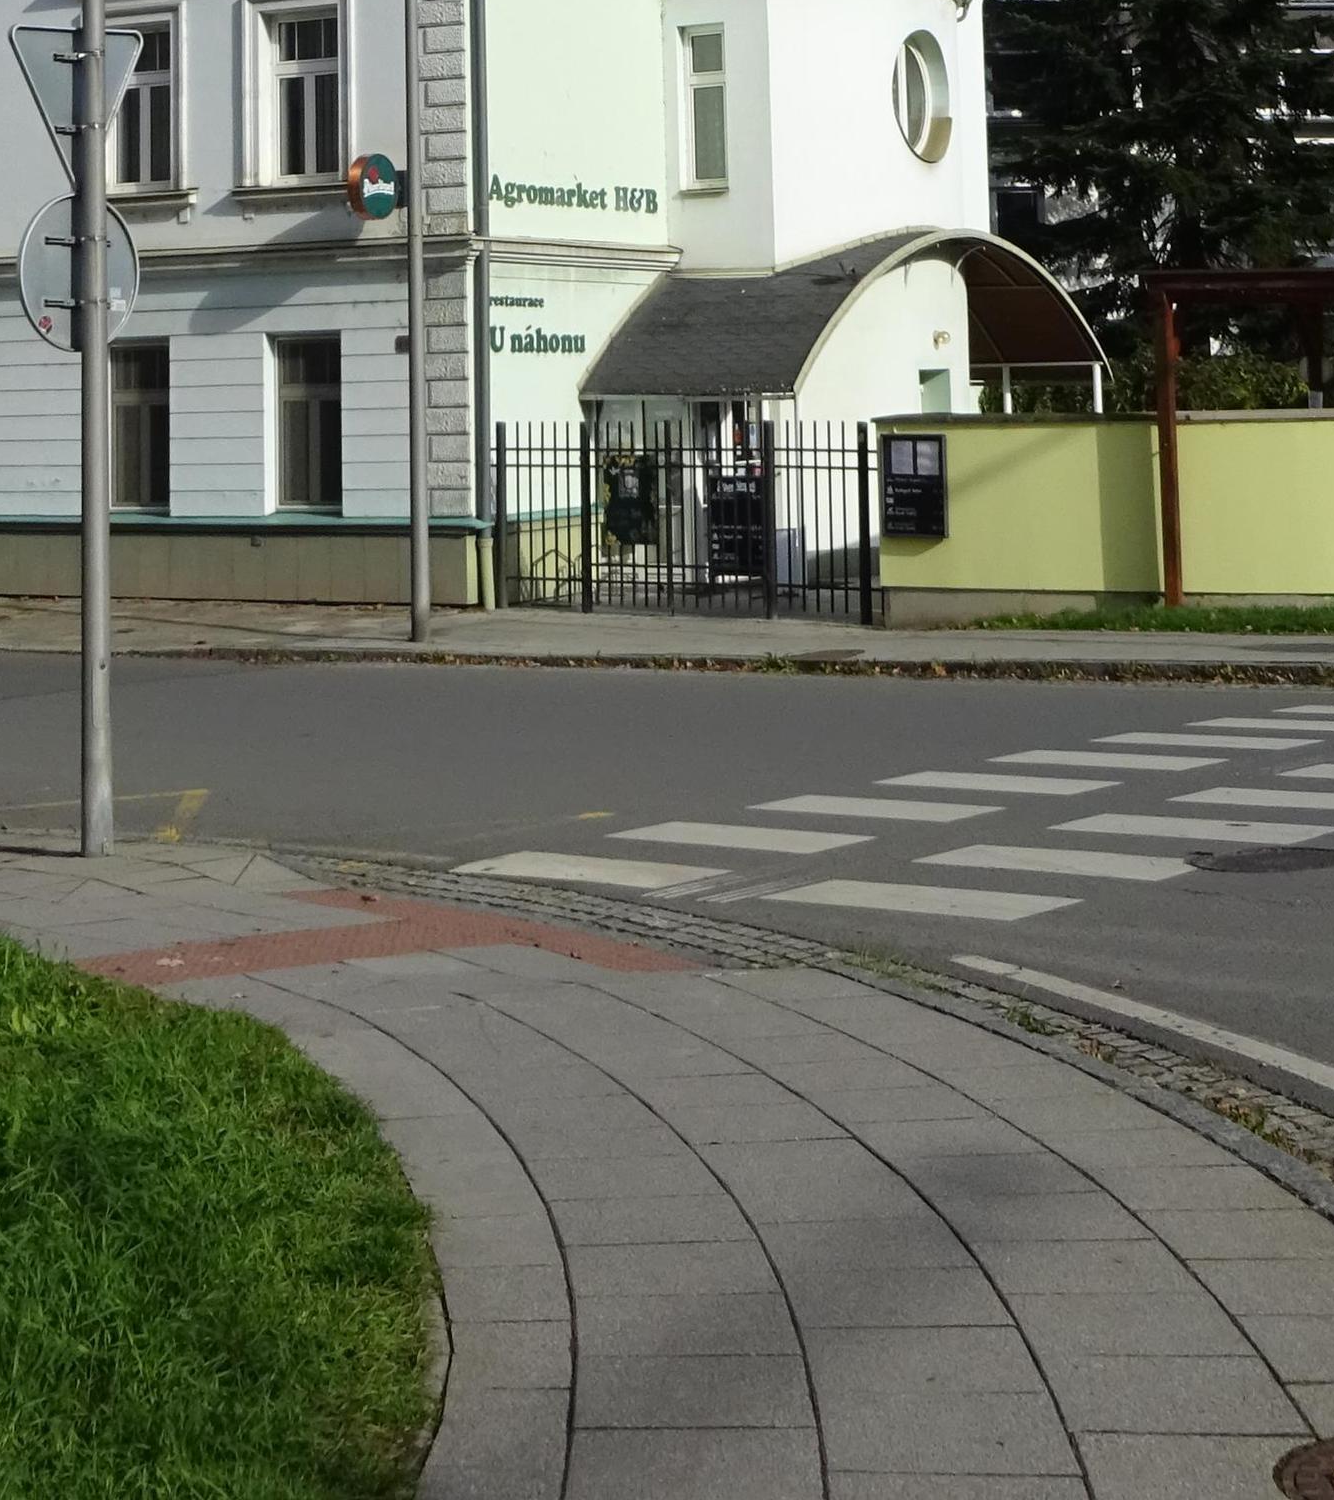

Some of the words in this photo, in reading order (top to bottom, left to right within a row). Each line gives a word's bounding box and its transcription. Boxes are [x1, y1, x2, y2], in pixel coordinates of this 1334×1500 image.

[489, 174, 607, 209] Agromarket
[614, 186, 659, 214] H&B
[489, 295, 545, 308] restaurace
[489, 325, 505, 353] U
[510, 325, 586, 353] náhonu
